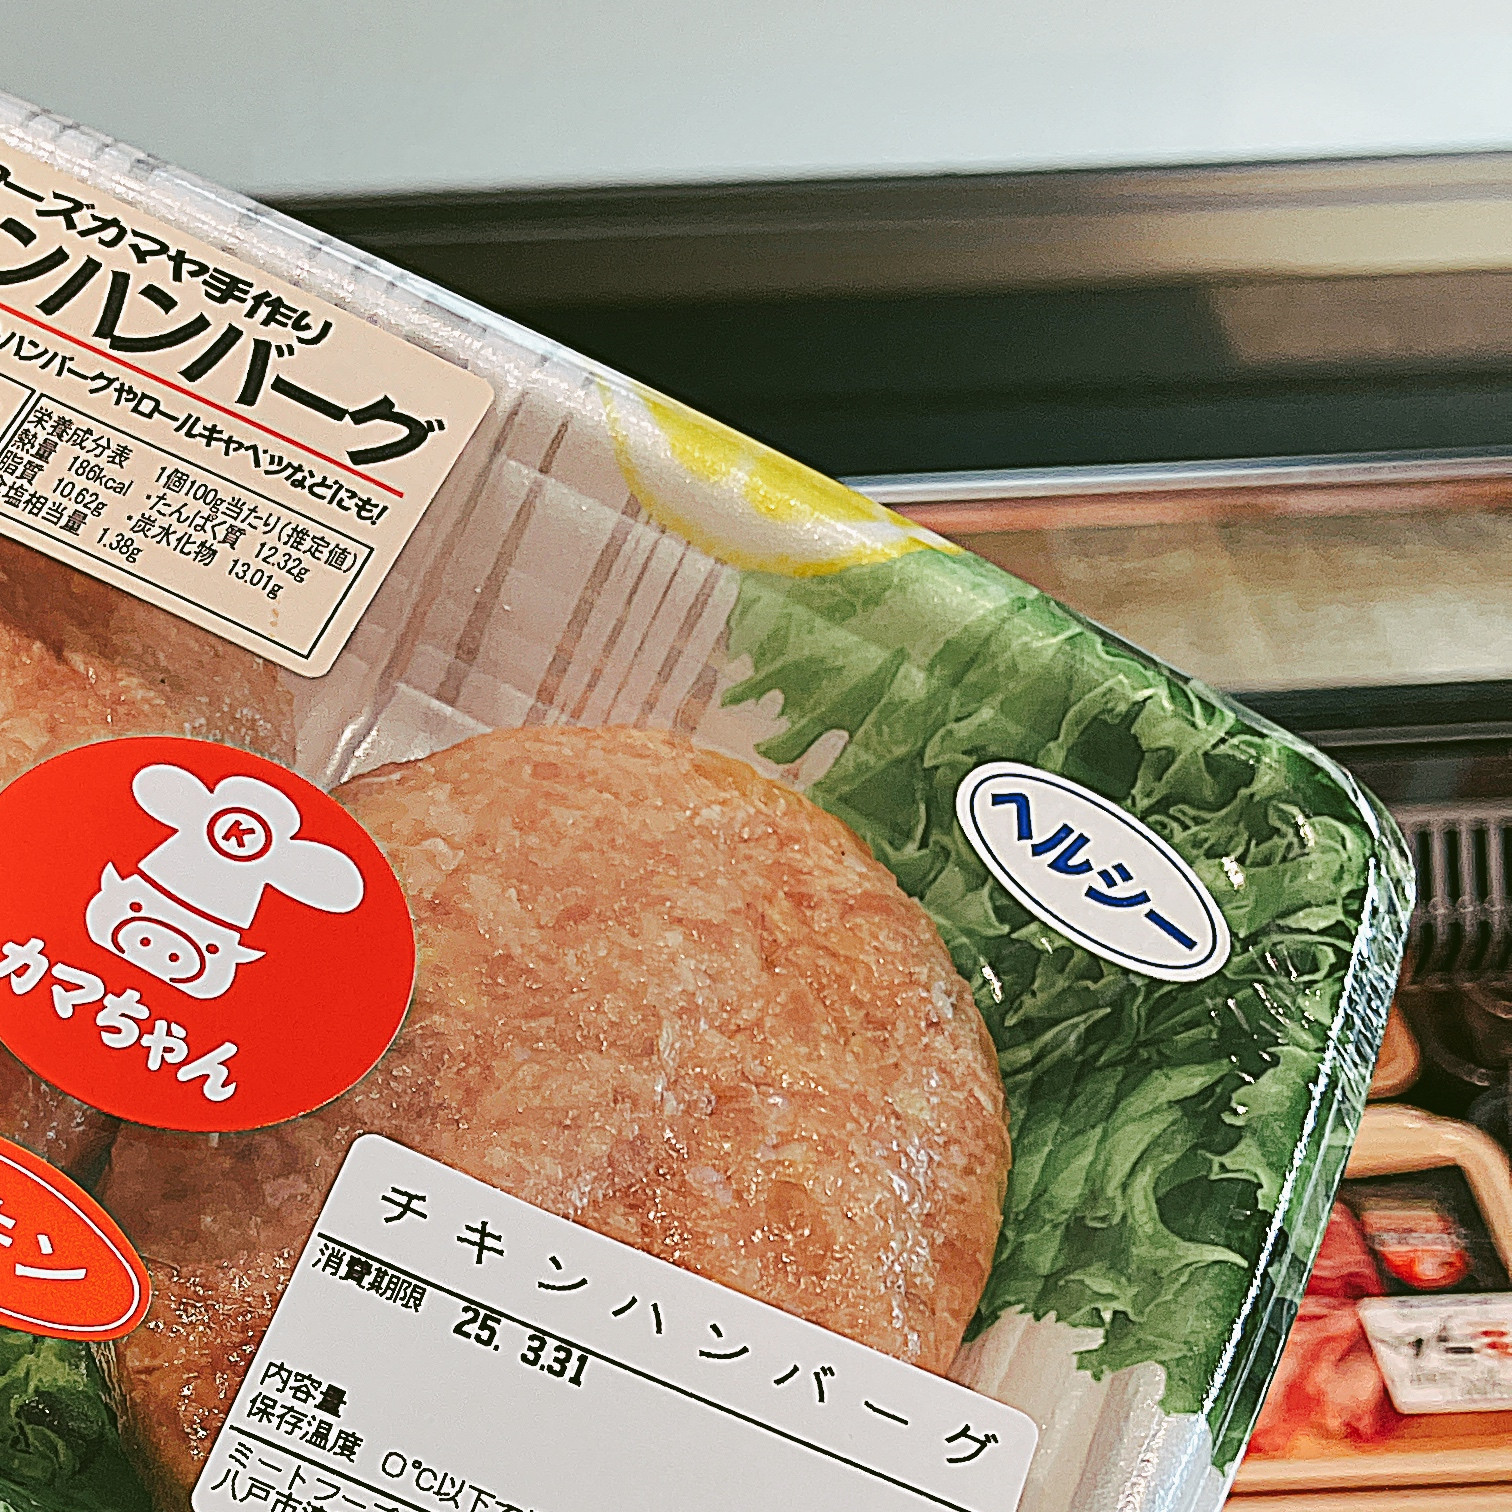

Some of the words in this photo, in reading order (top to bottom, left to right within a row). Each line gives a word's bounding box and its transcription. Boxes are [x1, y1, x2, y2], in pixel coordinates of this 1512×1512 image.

[10, 427, 59, 465] 熱量
[66, 455, 134, 497] 186kcal
[254, 541, 311, 584] 12.32g
[26, 405, 134, 469] 栄養成分表
[154, 466, 358, 574] 1個100g当たり(推定値)
[52, 477, 108, 518] 10.62g
[228, 558, 284, 601] 13.01g
[96, 527, 144, 564] 1.38g
[221, 819, 256, 849] K
[990, 792, 1198, 951] ヘルシー
[311, 1243, 427, 1313] 消費期限
[380, 1186, 999, 1464] チキンハンバーグ
[246, 1391, 364, 1464] 保存温度
[259, 1361, 348, 1419] 内容量
